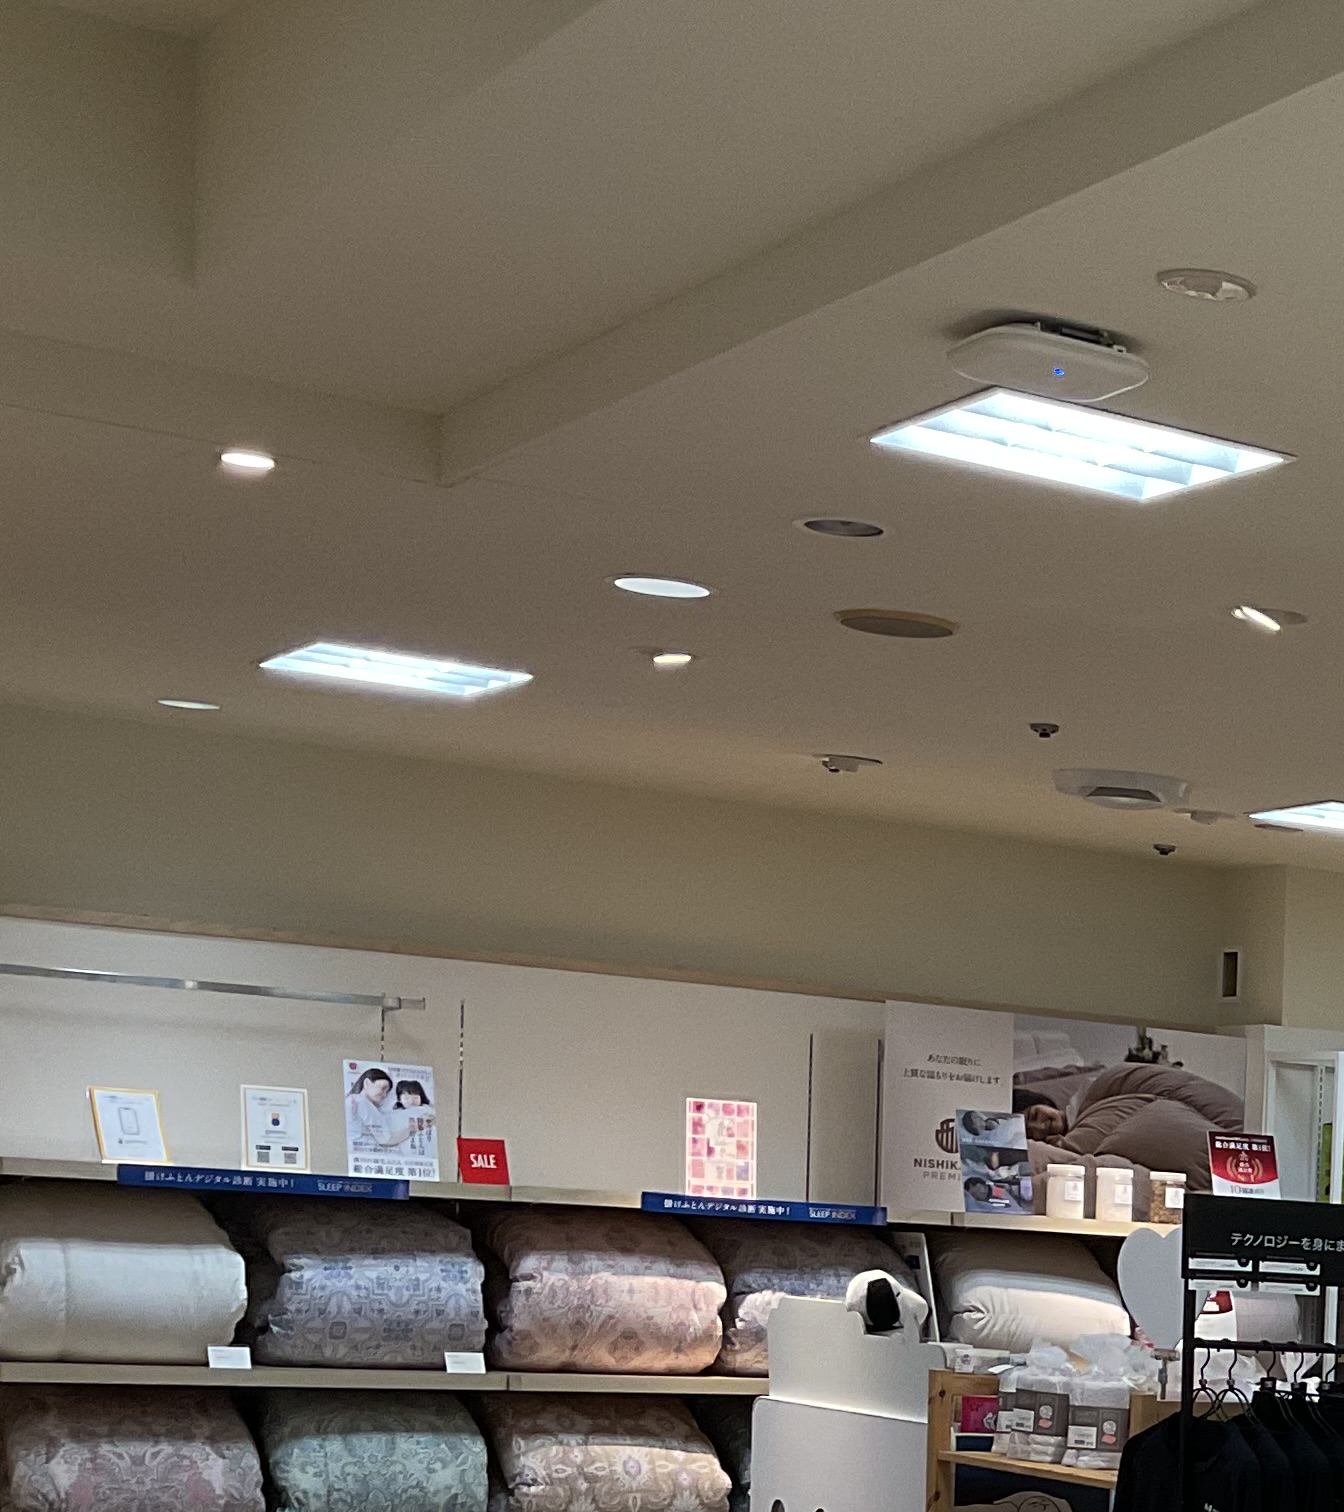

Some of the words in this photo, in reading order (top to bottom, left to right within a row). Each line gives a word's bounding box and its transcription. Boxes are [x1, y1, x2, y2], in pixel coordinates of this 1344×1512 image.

[470, 1153, 497, 1169] SALE
[914, 1157, 961, 1170] NISHIK
[318, 1182, 342, 1192] SLEEP
[809, 1209, 831, 1219] SLEEP
[832, 1211, 856, 1220] INDEX
